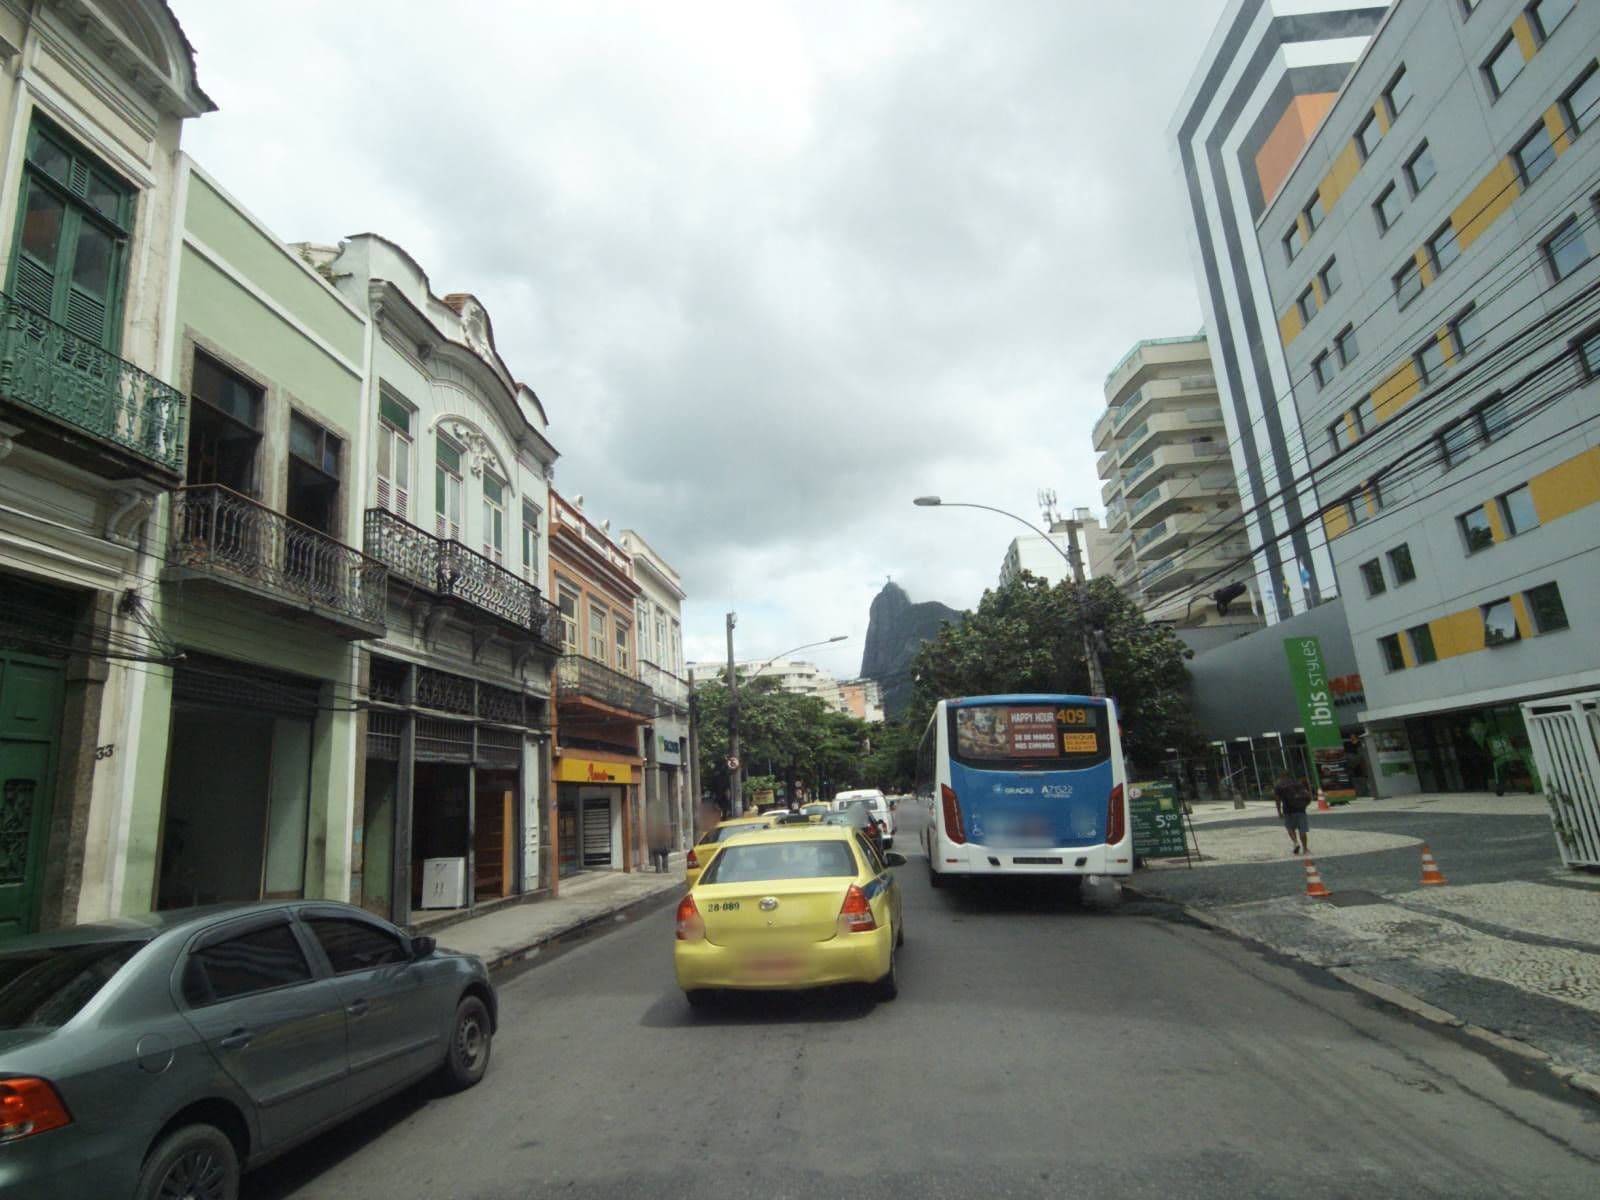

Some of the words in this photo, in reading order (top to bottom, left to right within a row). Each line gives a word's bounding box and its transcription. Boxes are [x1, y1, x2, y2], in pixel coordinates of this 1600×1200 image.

[1057, 709, 1086, 724] 409
[1308, 691, 1333, 726] ibis
[1011, 711, 1033, 723] HAPPY
[1035, 711, 1054, 722] HOUR
[96, 743, 115, 760] 33
